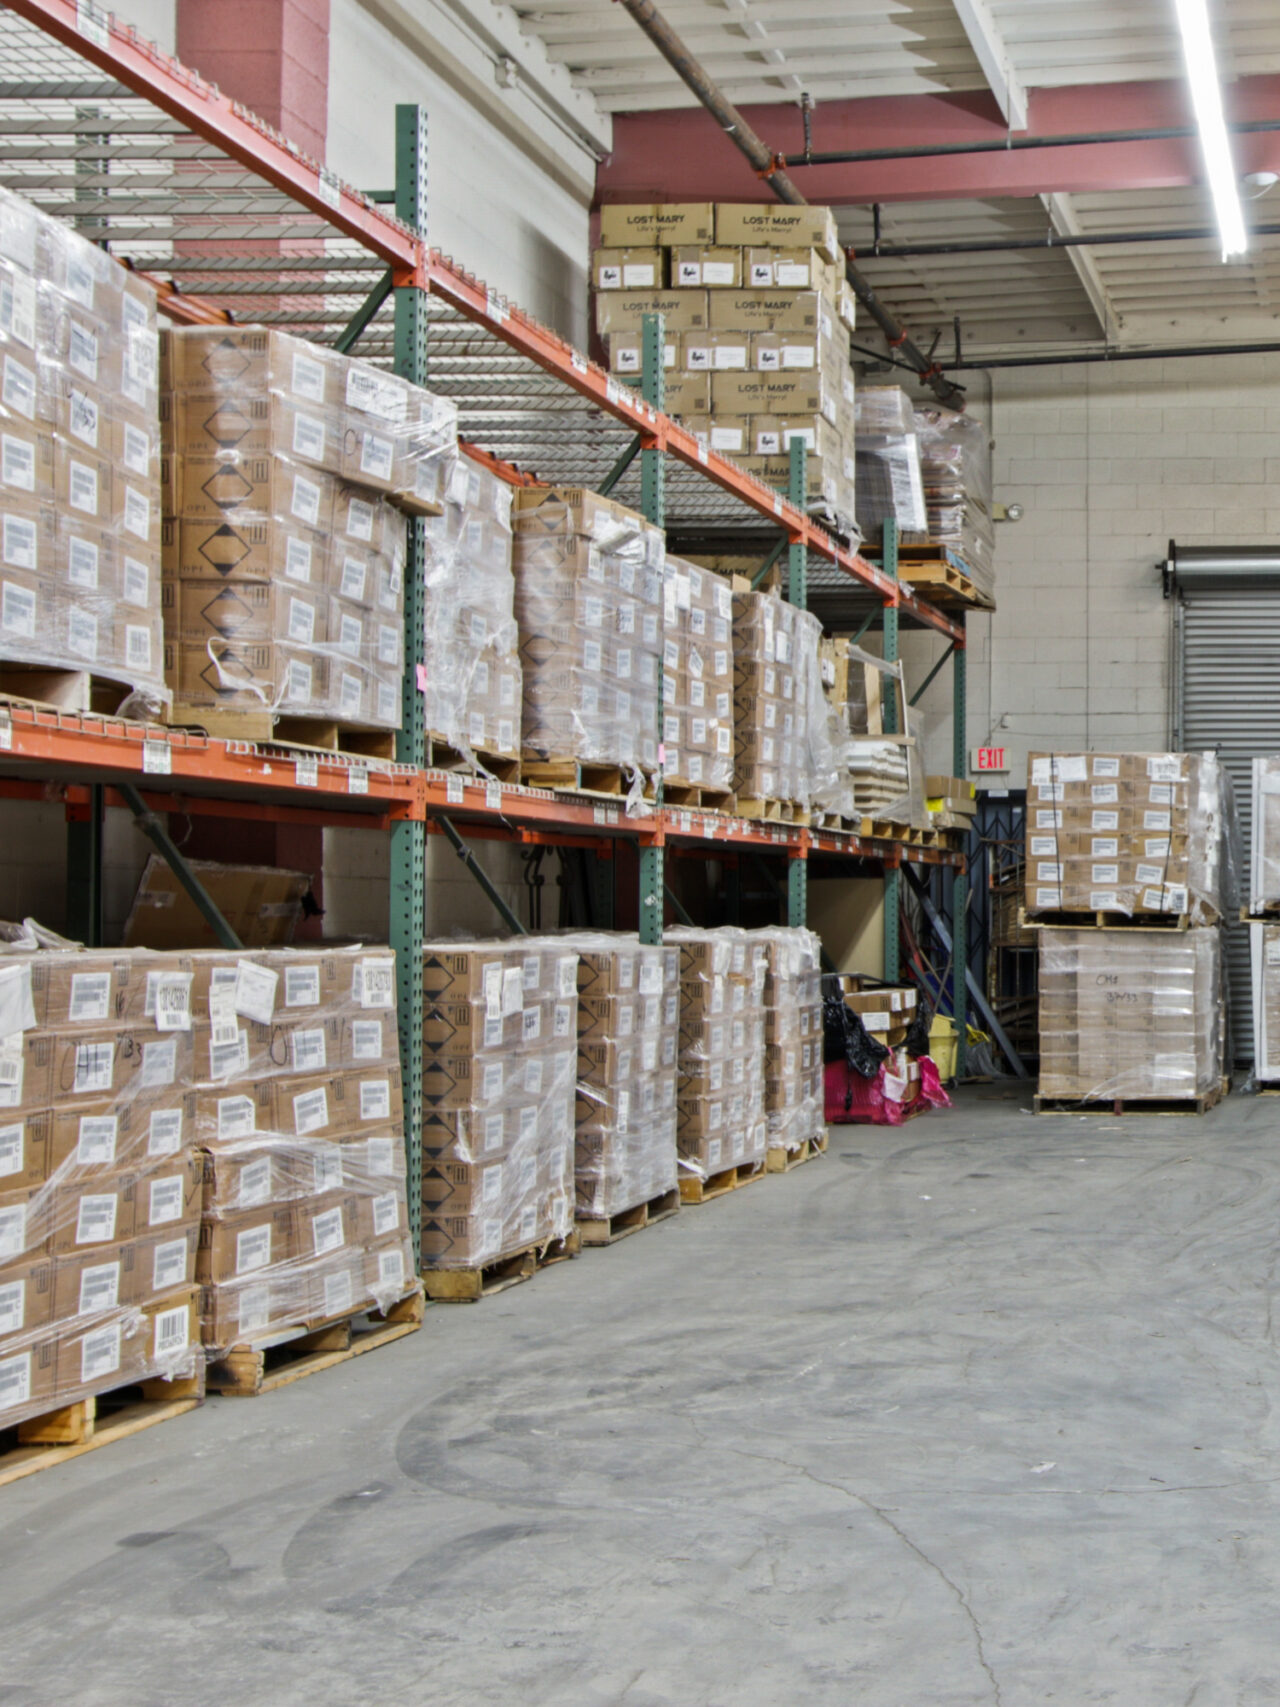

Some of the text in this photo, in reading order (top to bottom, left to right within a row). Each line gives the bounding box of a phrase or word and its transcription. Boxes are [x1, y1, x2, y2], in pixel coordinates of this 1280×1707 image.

[627, 215, 685, 224] LOST MARY
[743, 216, 801, 225] LOST MARY
[623, 301, 680, 311] LOST MARY
[735, 301, 792, 309] LOST MARY
[664, 384, 683, 393] ARY
[738, 384, 796, 393] LOST MARY
[978, 748, 1005, 769] EXIT
